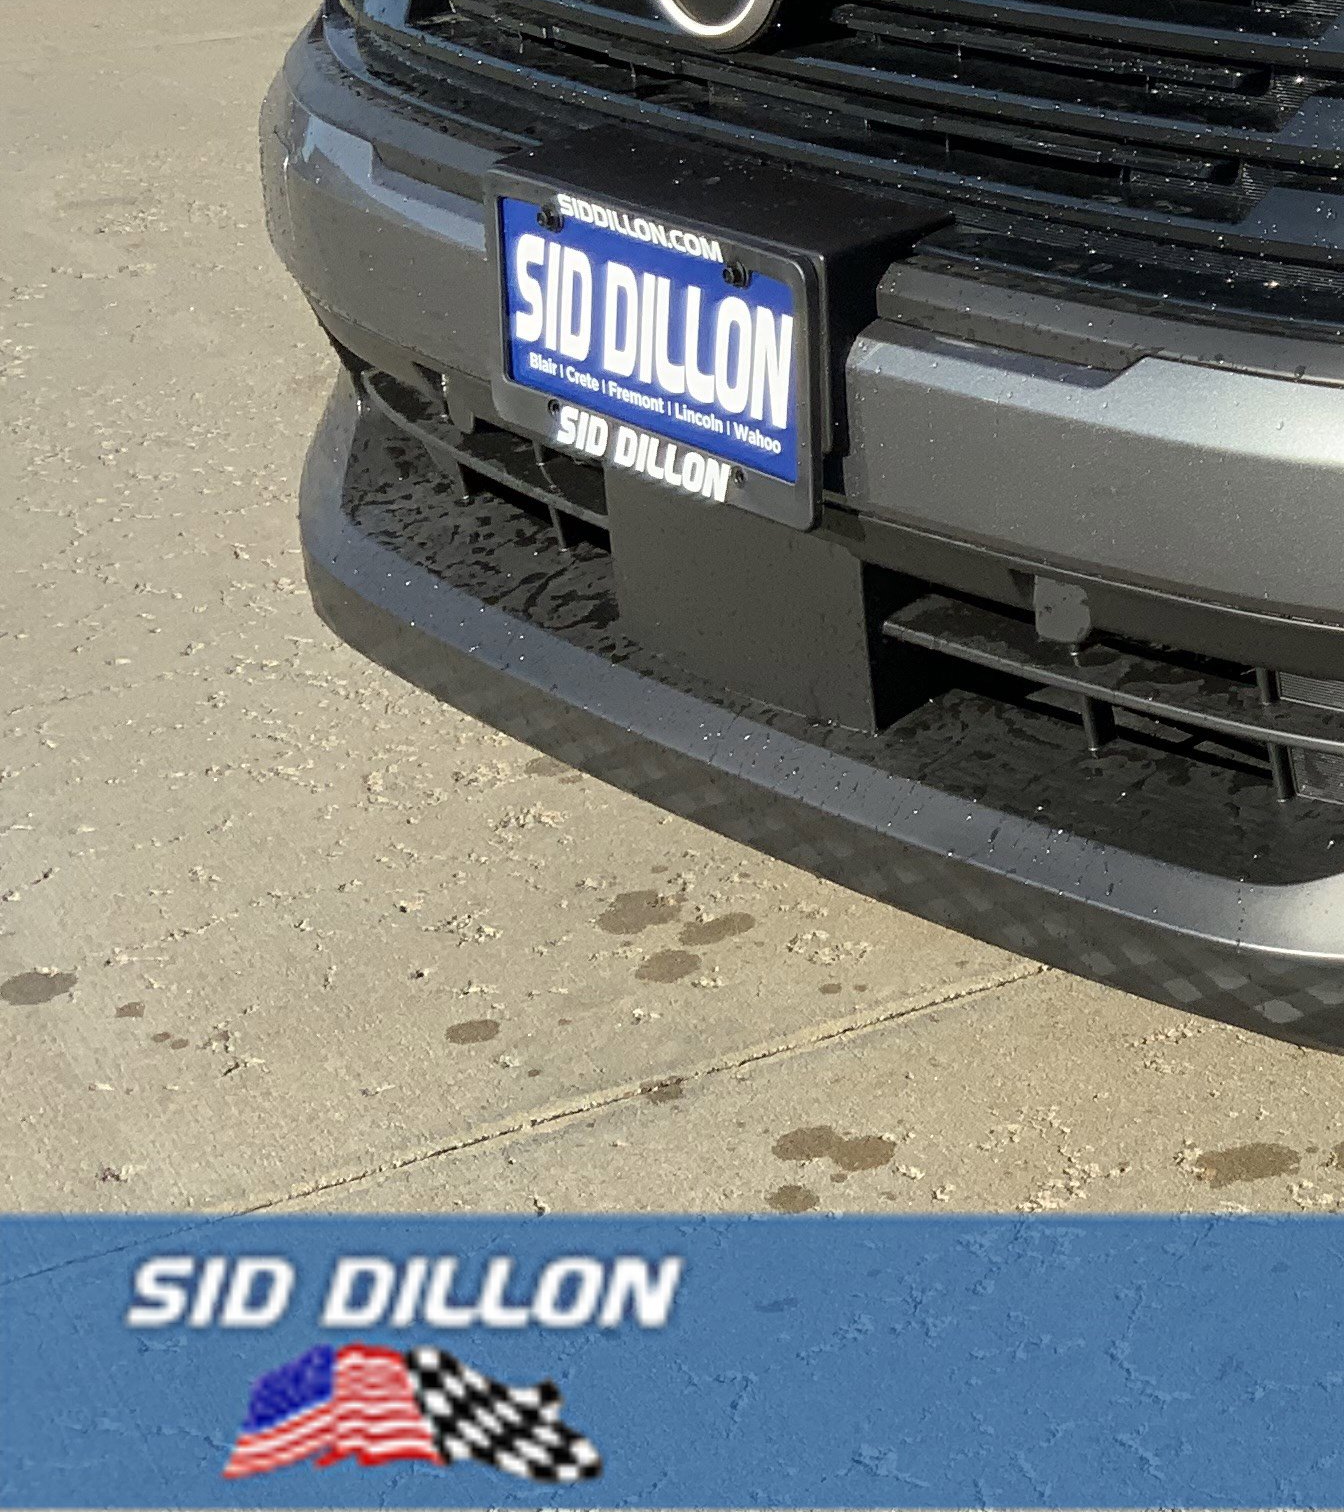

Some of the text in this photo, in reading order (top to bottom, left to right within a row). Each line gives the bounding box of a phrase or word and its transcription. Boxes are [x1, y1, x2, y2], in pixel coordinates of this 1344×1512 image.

[556, 193, 724, 264] SIDDILLON.COM
[514, 233, 794, 429] SID DILLON
[529, 352, 782, 455] Blair Crete Fremont Lincoln Wahoo
[556, 405, 732, 503] SID DILLON
